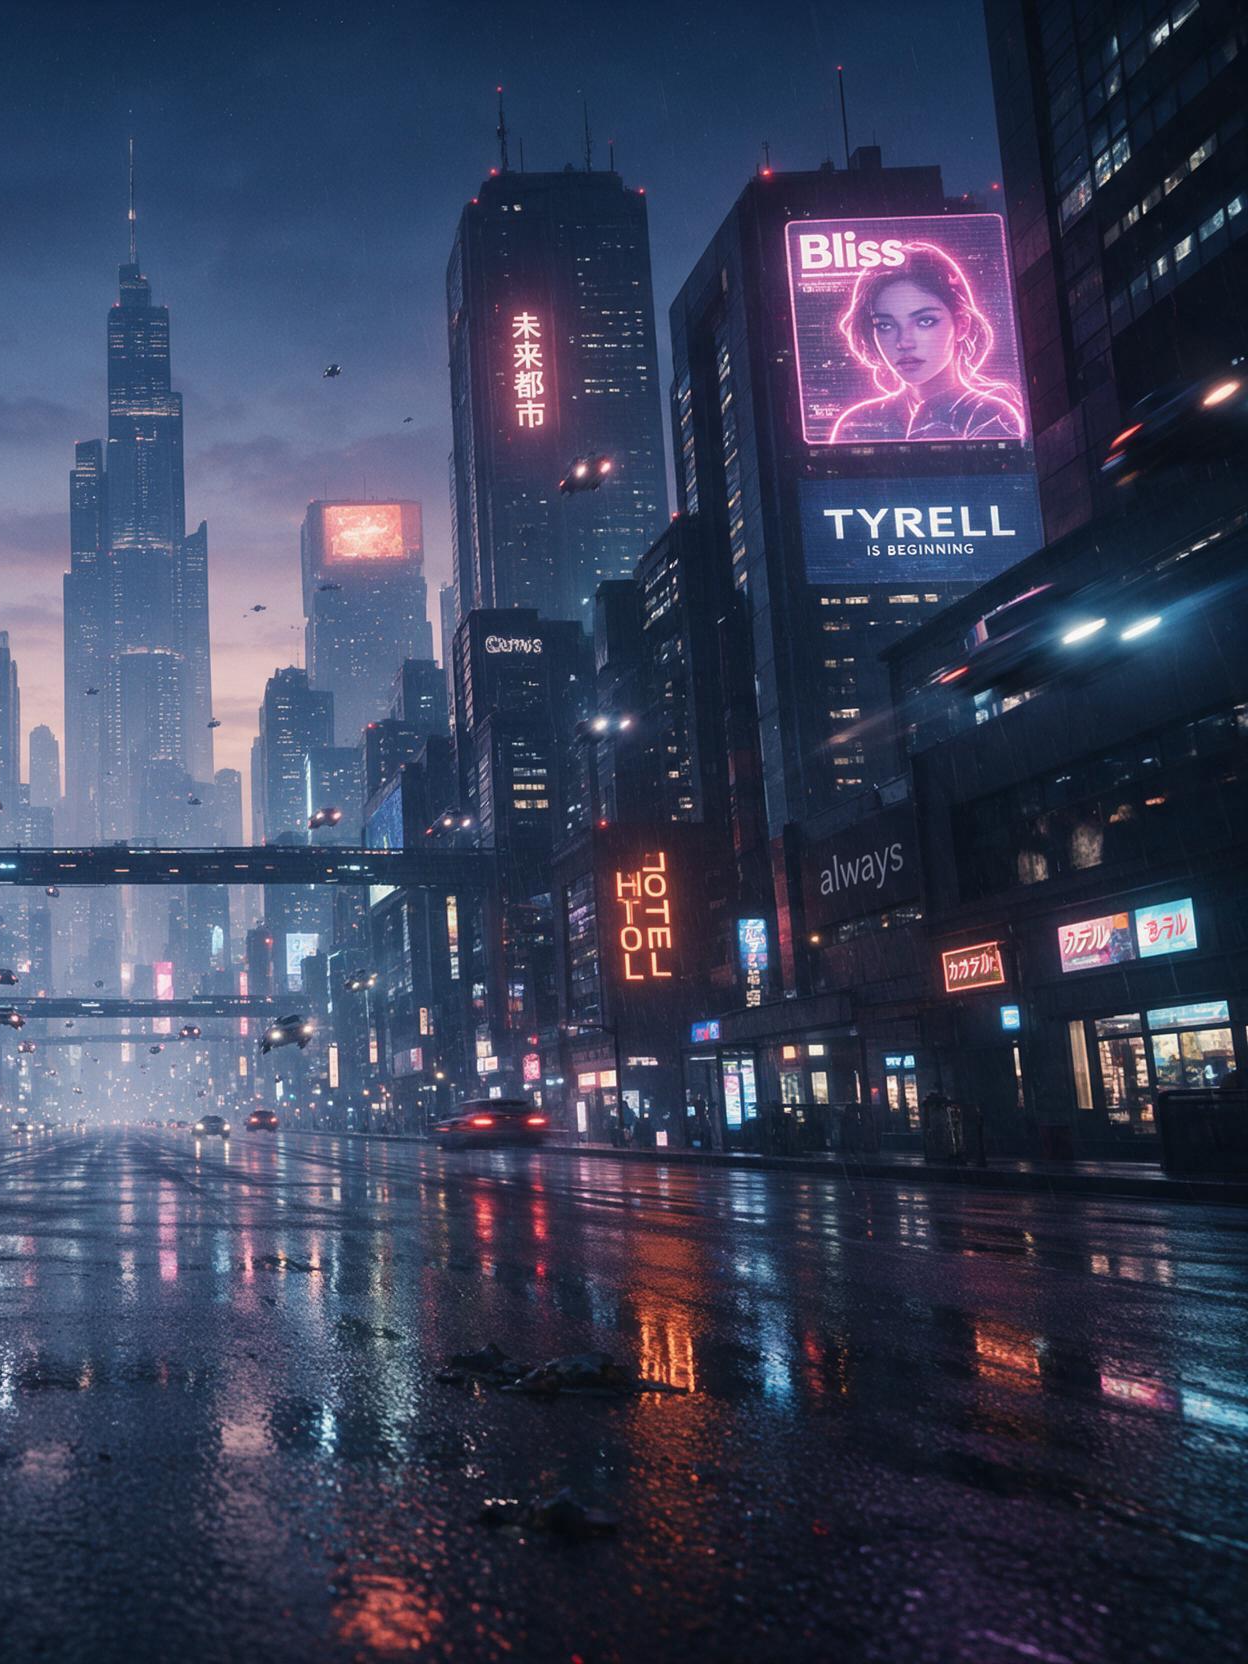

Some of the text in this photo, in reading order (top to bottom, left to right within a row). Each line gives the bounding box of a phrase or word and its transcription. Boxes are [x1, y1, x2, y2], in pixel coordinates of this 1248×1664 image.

[799, 231, 906, 269] Bliss
[511, 311, 546, 429] 未来都市
[823, 505, 1016, 540] TYRELL
[867, 543, 974, 557] IS BEGINNING
[820, 843, 904, 896] always
